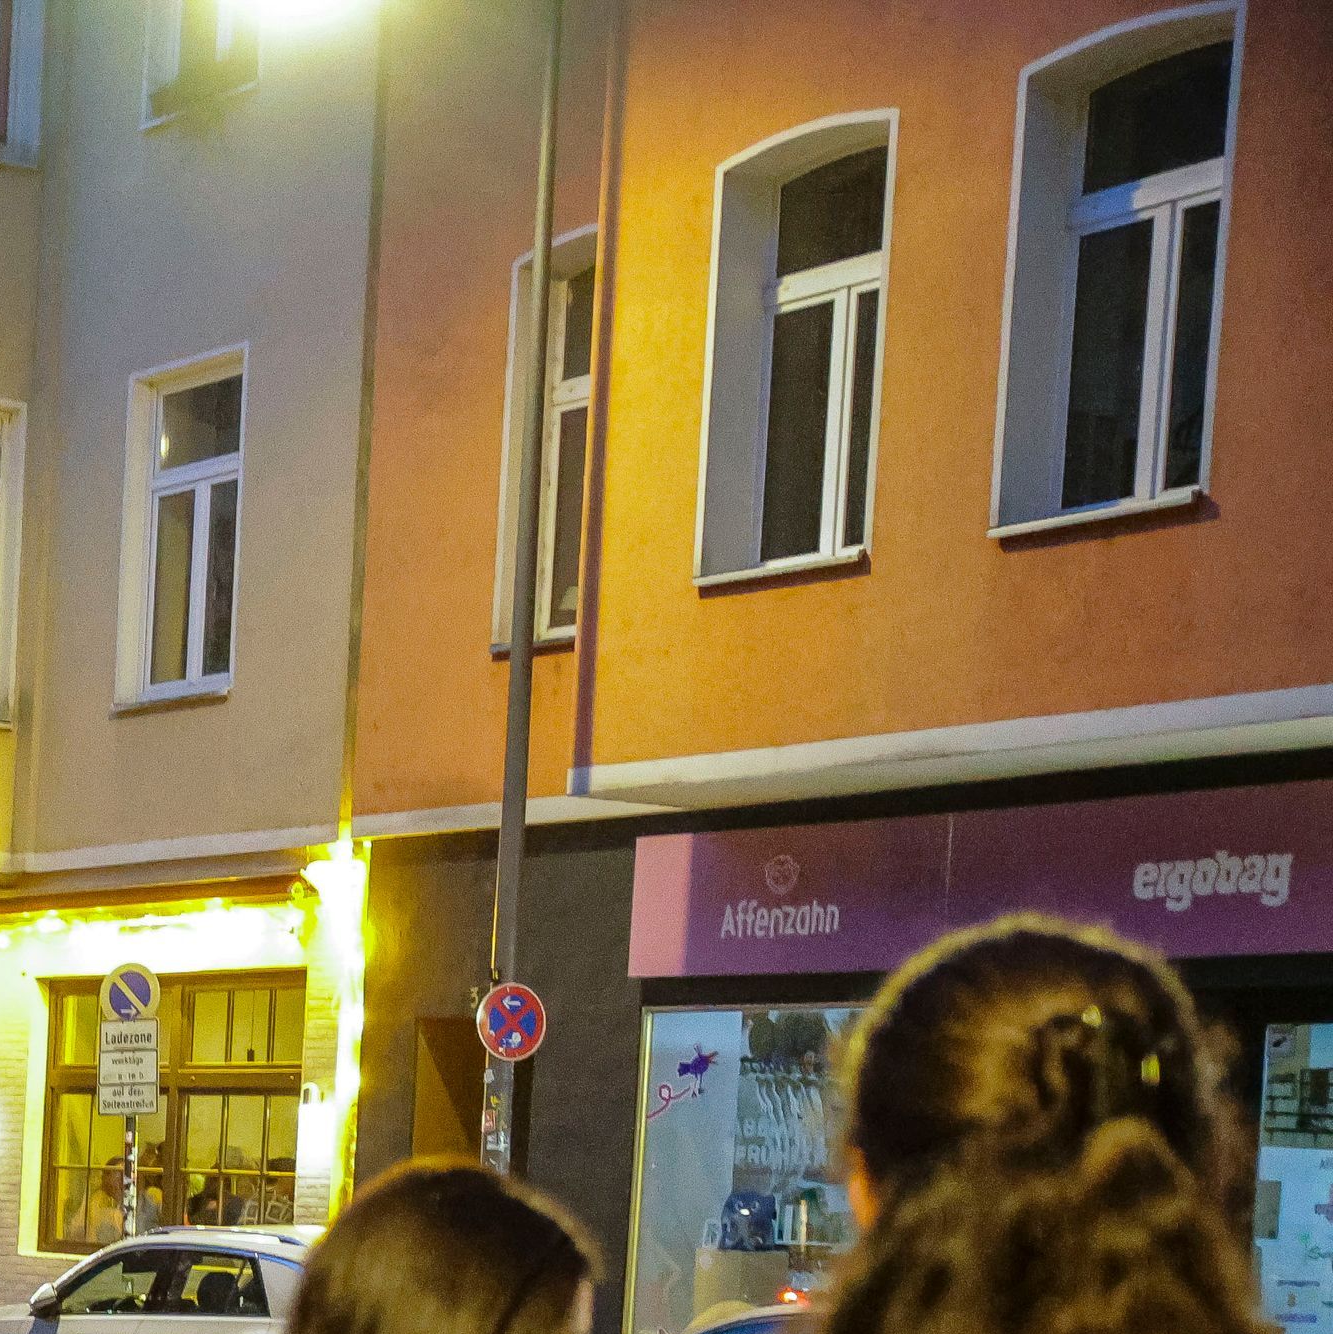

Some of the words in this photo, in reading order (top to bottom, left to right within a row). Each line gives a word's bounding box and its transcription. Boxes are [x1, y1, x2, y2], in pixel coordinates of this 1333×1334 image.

[1134, 850, 1294, 912] ergobag
[720, 899, 840, 939] Affenzahn
[105, 1032, 153, 1045] Ladezone
